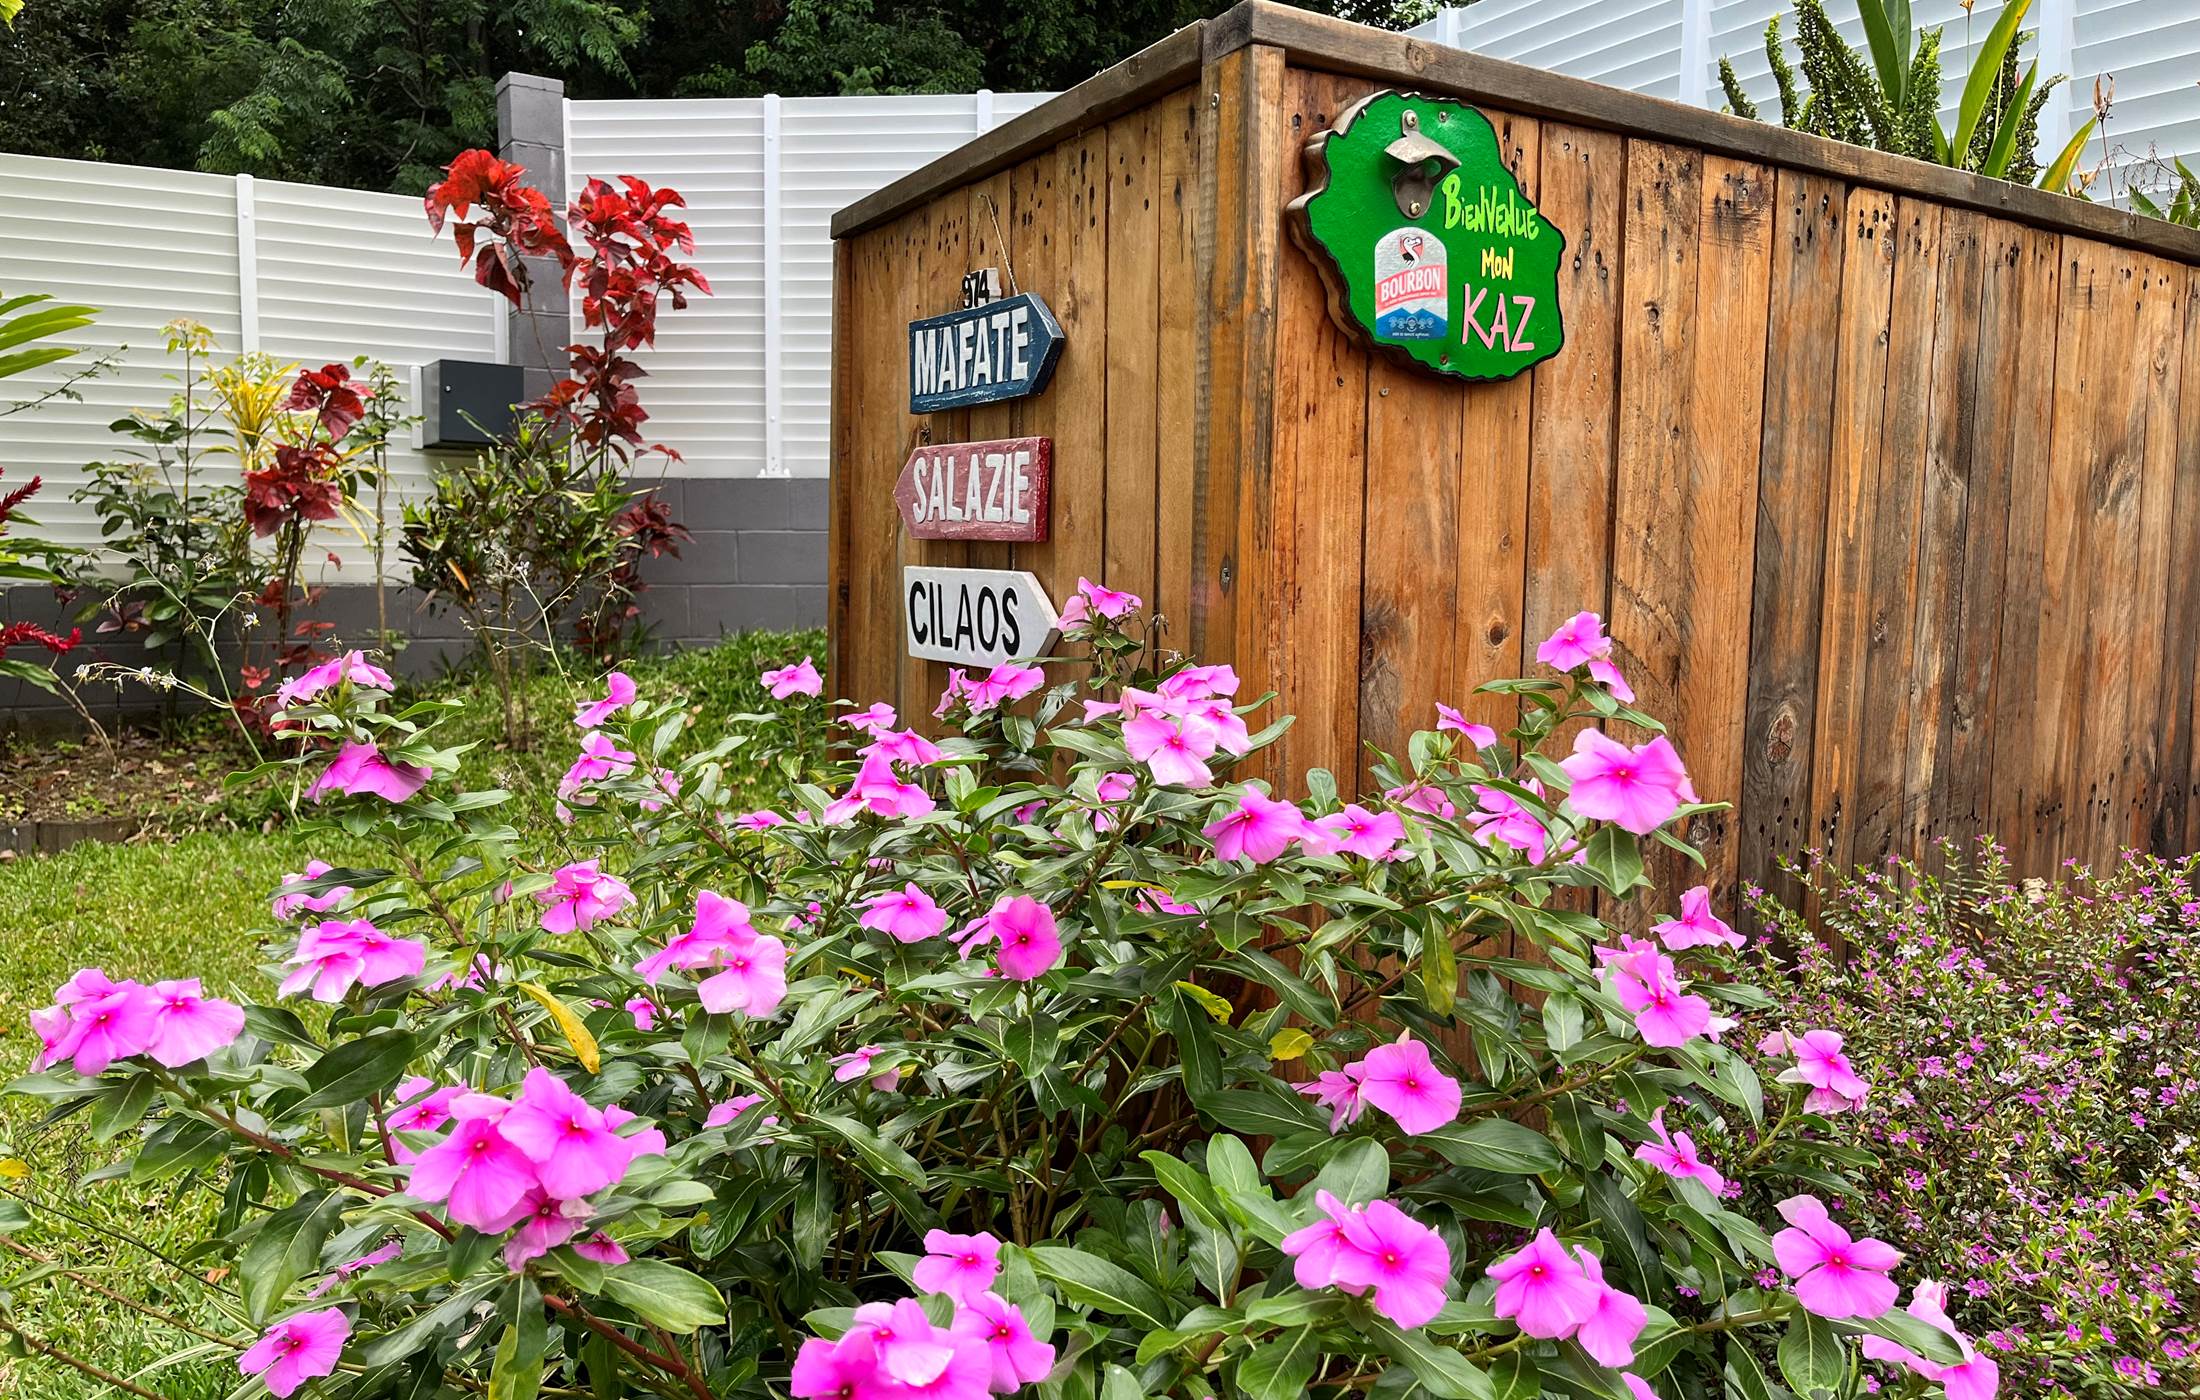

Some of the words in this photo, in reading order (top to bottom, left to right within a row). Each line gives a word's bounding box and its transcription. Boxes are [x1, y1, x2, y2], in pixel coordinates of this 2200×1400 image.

[962, 269, 990, 309] 974
[1381, 268, 1441, 303] BOURBON
[1461, 283, 1536, 352] KAZ
[914, 306, 1029, 396] MAFATE
[912, 451, 1030, 524] SALAZIE
[909, 580, 1021, 656] CILAOS
